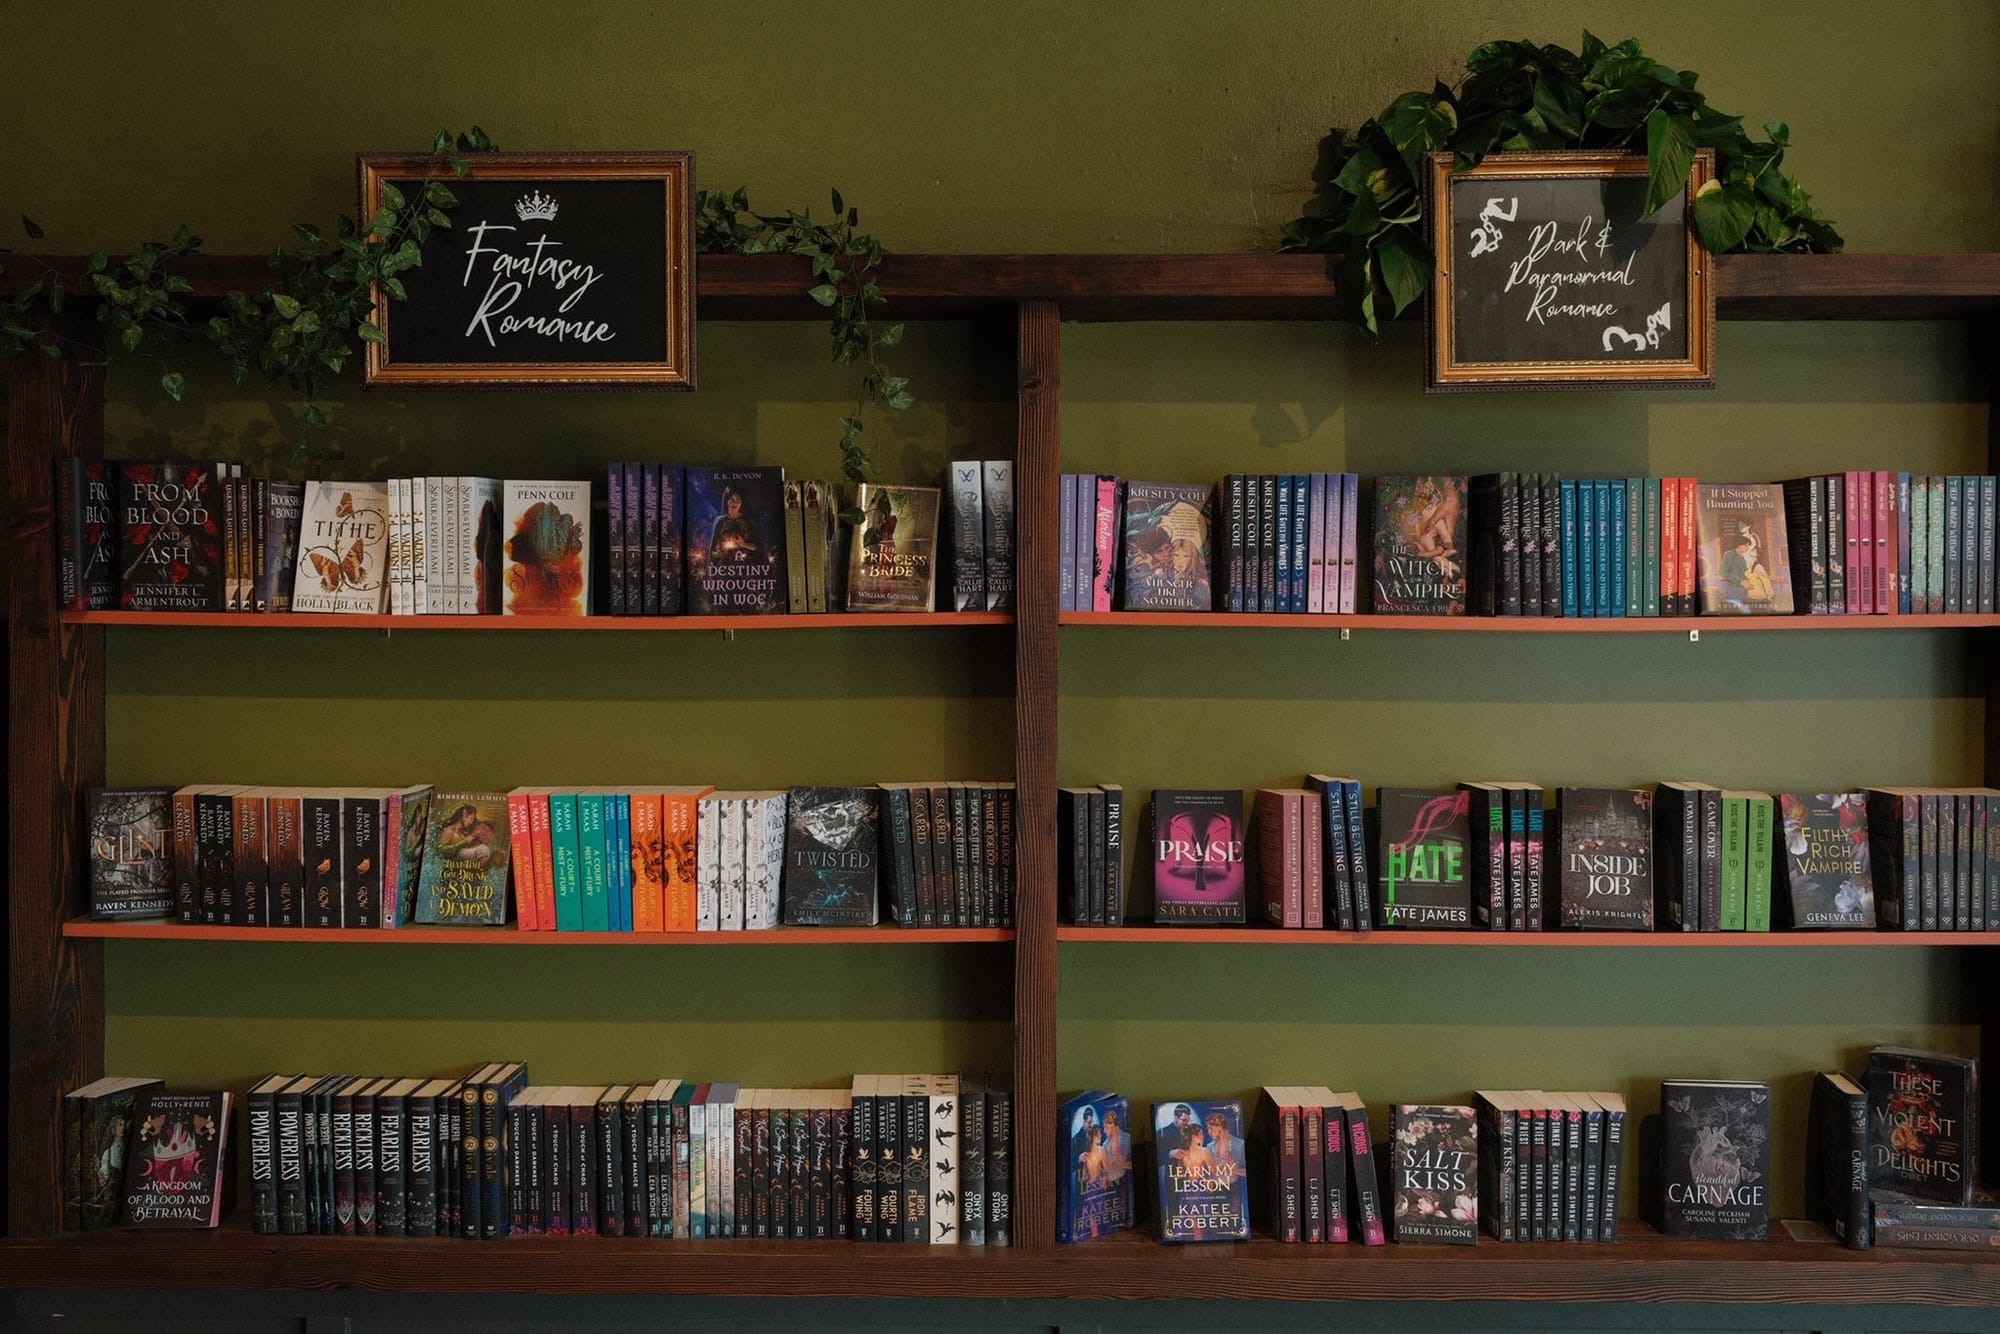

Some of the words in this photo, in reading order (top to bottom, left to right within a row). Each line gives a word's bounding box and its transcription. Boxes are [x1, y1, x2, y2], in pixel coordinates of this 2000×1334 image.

[1525, 214, 1592, 263] Dark
[1595, 219, 1614, 258] &
[463, 220, 604, 312] Fantasy
[1504, 250, 1636, 293] Paranormal
[465, 272, 616, 347] Romance
[1526, 285, 1619, 326] Romance
[132, 483, 201, 502] FROM
[519, 491, 546, 500] PENN
[549, 491, 576, 500] COLE
[1130, 489, 1176, 500] KRESLEY
[1179, 491, 1208, 501] COLE
[1232, 480, 1241, 520] KRESLEY
[1711, 489, 1719, 497] If
[1728, 489, 1768, 501] Stopped
[127, 507, 209, 525] BLOOD
[1706, 500, 1755, 511] Haunting
[1757, 501, 1774, 509] You
[157, 532, 180, 541] AND
[315, 521, 376, 539] TITHE
[1232, 523, 1240, 548] COLE
[145, 547, 191, 564] ASH
[415, 531, 423, 570] VALIANT
[863, 548, 928, 566] PRINCESS
[708, 565, 770, 576] DESTINY
[869, 564, 914, 577] BRIDE
[1389, 559, 1453, 576] WITCH
[135, 586, 190, 596] JENNIFER
[192, 587, 201, 596] L.
[703, 579, 776, 591] WROUGHT
[959, 584, 982, 592] HART
[1374, 580, 1462, 604] VAMPIRE
[129, 597, 209, 608] ARMENTROUT
[296, 598, 334, 609] HOLLY
[336, 599, 373, 610] BLACK
[713, 594, 729, 605] IN
[734, 594, 767, 605] WOE
[563, 803, 571, 830] SARAH
[1330, 791, 1340, 820] STILL
[1348, 793, 1358, 822] STILL
[199, 804, 208, 844] KENNEDY
[207, 809, 216, 838] RAVEN
[315, 807, 323, 848] KENNEDY
[1108, 803, 1120, 850] PRAISE
[1491, 807, 1503, 831] HATE
[97, 827, 174, 865] GLINT
[1801, 827, 1850, 842] FILTHY
[794, 850, 871, 868] TWISTED
[1159, 839, 1243, 863] PRAISE
[1333, 824, 1345, 872] BEATING
[1351, 825, 1364, 873] BEATING
[1811, 842, 1852, 858] RICH
[1388, 844, 1464, 881] HATE
[1513, 854, 1521, 875] TATE
[1569, 854, 1647, 877] INSIDE
[1797, 858, 1862, 875] VAMPIRE
[1492, 877, 1502, 908] JAMES
[1512, 878, 1521, 908] JAMES
[1529, 878, 1538, 909] JAMES
[1586, 875, 1631, 899] JOB
[95, 902, 127, 911] RAVEN
[130, 900, 175, 908] KENNEDY
[438, 900, 492, 918] DEMON
[1159, 906, 1198, 916] SARA
[1203, 906, 1242, 917] CATE
[1384, 906, 1416, 918] TATE
[1420, 908, 1467, 922] JAMES
[1568, 908, 1601, 917] ALEXIS
[1806, 913, 1845, 922] GENEVA
[1849, 913, 1865, 922] LEE
[1888, 1071, 1944, 1096] THESE
[1610, 1122, 1620, 1143] SAINT
[1876, 1106, 1956, 1137] VIOLENT
[250, 1111, 271, 1180] POWERLESS
[279, 1111, 300, 1180] POWERLESS
[334, 1113, 352, 1170] RECKLESS
[355, 1113, 373, 1170] RECKLESS
[381, 1115, 399, 1172] FEARLESS
[412, 1115, 431, 1173] FEARLESS
[1327, 1120, 1340, 1153] VICIOUS
[1352, 1122, 1368, 1155] VICIOUS
[1168, 1164, 1212, 1178] LEARN
[1215, 1162, 1237, 1176] MY
[1404, 1149, 1469, 1170] SALT
[1851, 1150, 1862, 1192] CARNAGE
[1871, 1144, 1961, 1182] DELIGHTS
[152, 1181, 202, 1193] KINGDOM
[648, 1175, 656, 1191] LEIA
[1174, 1178, 1231, 1193] LESSON
[1403, 1170, 1467, 1192] KISS
[1695, 1173, 1740, 1187] Beautiful
[128, 1196, 142, 1205] OF
[144, 1194, 184, 1207] BLOOD
[187, 1195, 210, 1205] AND
[649, 1193, 657, 1218] STONE
[864, 1189, 872, 1223] FOURTH
[908, 1189, 917, 1222] FLAME
[917, 1195, 925, 1216] IRON
[964, 1191, 973, 1221] STORM
[973, 1194, 981, 1218] ONYX
[1668, 1183, 1764, 1206] CARNAGE
[132, 1207, 208, 1222] BETRAYAL
[856, 1195, 864, 1219] WING
[880, 1196, 889, 1219] WING
[889, 1190, 897, 1224] FOURTH
[992, 1192, 1000, 1222] STORM
[1000, 1194, 1009, 1219] ONYX
[1179, 1204, 1231, 1215] KATEE
[1681, 1209, 1715, 1217] CAROLINE
[1717, 1210, 1751, 1218] PECKHAM
[1172, 1217, 1239, 1228] ROBERT
[1399, 1224, 1432, 1236] SIERRA
[1435, 1227, 1472, 1238] SIMONE
[1719, 1216, 1747, 1224] VALENTI
